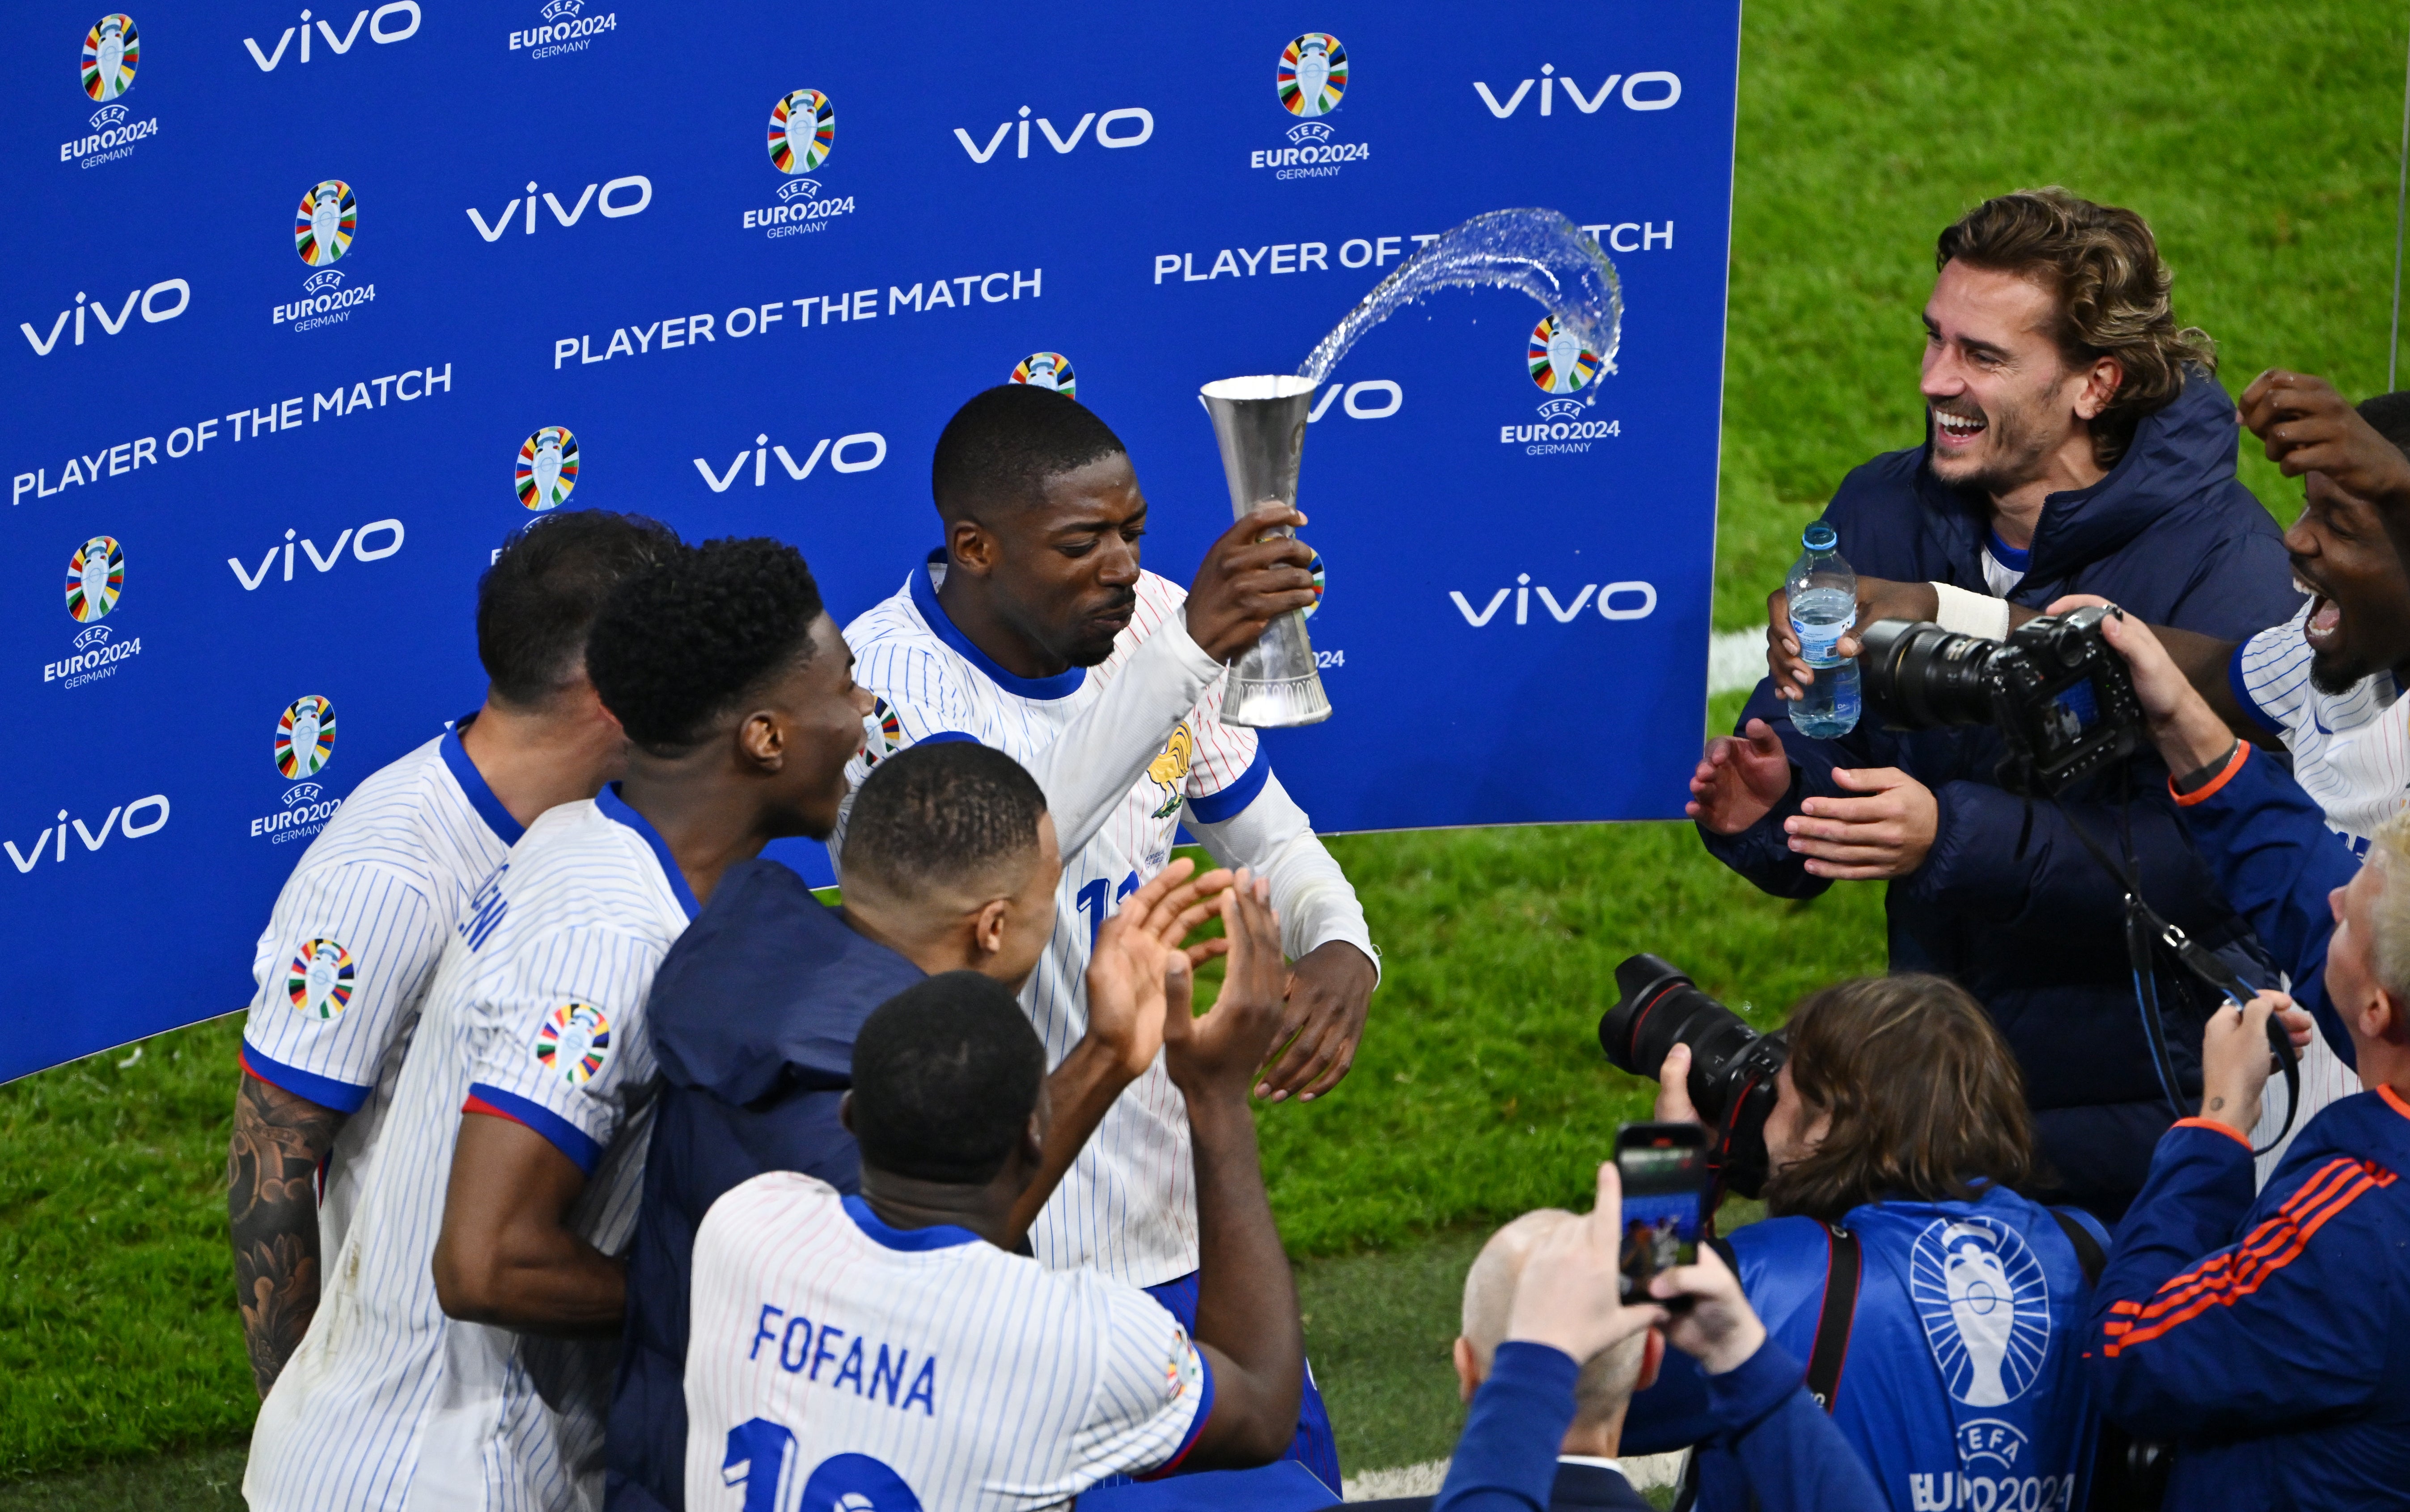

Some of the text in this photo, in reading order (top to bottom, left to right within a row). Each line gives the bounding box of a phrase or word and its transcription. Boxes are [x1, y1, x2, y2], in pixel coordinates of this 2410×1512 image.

[543, 0, 580, 19] UEFA
[243, 0, 421, 72] vivo
[509, 13, 617, 50] EURO2024
[532, 38, 592, 59] GERMANY
[1473, 63, 1681, 118] vivo
[91, 108, 125, 127] UEFA
[953, 105, 1154, 164] vivo
[1289, 126, 1330, 141] UEFA
[61, 118, 158, 161] EURO2024
[81, 145, 134, 169] GERMANY
[1251, 143, 1369, 168] EURO2024
[779, 182, 817, 199] UEFA
[1276, 165, 1339, 180] GERMANY
[466, 175, 652, 242] vivo
[743, 196, 855, 228] EURO2024
[767, 220, 829, 239] GERMANY
[1155, 242, 1328, 284] PLAYER
[1339, 237, 1401, 268] OF
[1581, 221, 1674, 252] TCH
[305, 273, 341, 291] UEFA
[20, 278, 190, 356] vivo
[273, 284, 375, 324] EURO2024
[294, 309, 352, 333] GERMANY
[555, 268, 1042, 369] PLAYER OF THE MATCH
[1539, 402, 1580, 417] UEFA
[13, 363, 451, 506] PLAYER OF THE MATCH
[1501, 420, 1621, 443] EURO2024
[1526, 442, 1592, 455] GERMANY
[693, 432, 887, 492] vivo
[228, 519, 404, 591] vivo
[1449, 573, 1657, 627] vivo
[75, 629, 109, 648] UEFA
[44, 638, 141, 682] EURO2024
[64, 664, 119, 689] GERMANY
[284, 786, 318, 804] UEFA
[3, 794, 170, 873] vivo
[250, 798, 342, 837] EURO202
[1076, 869, 1141, 958] 1
[750, 1303, 935, 1416] FOFANA
